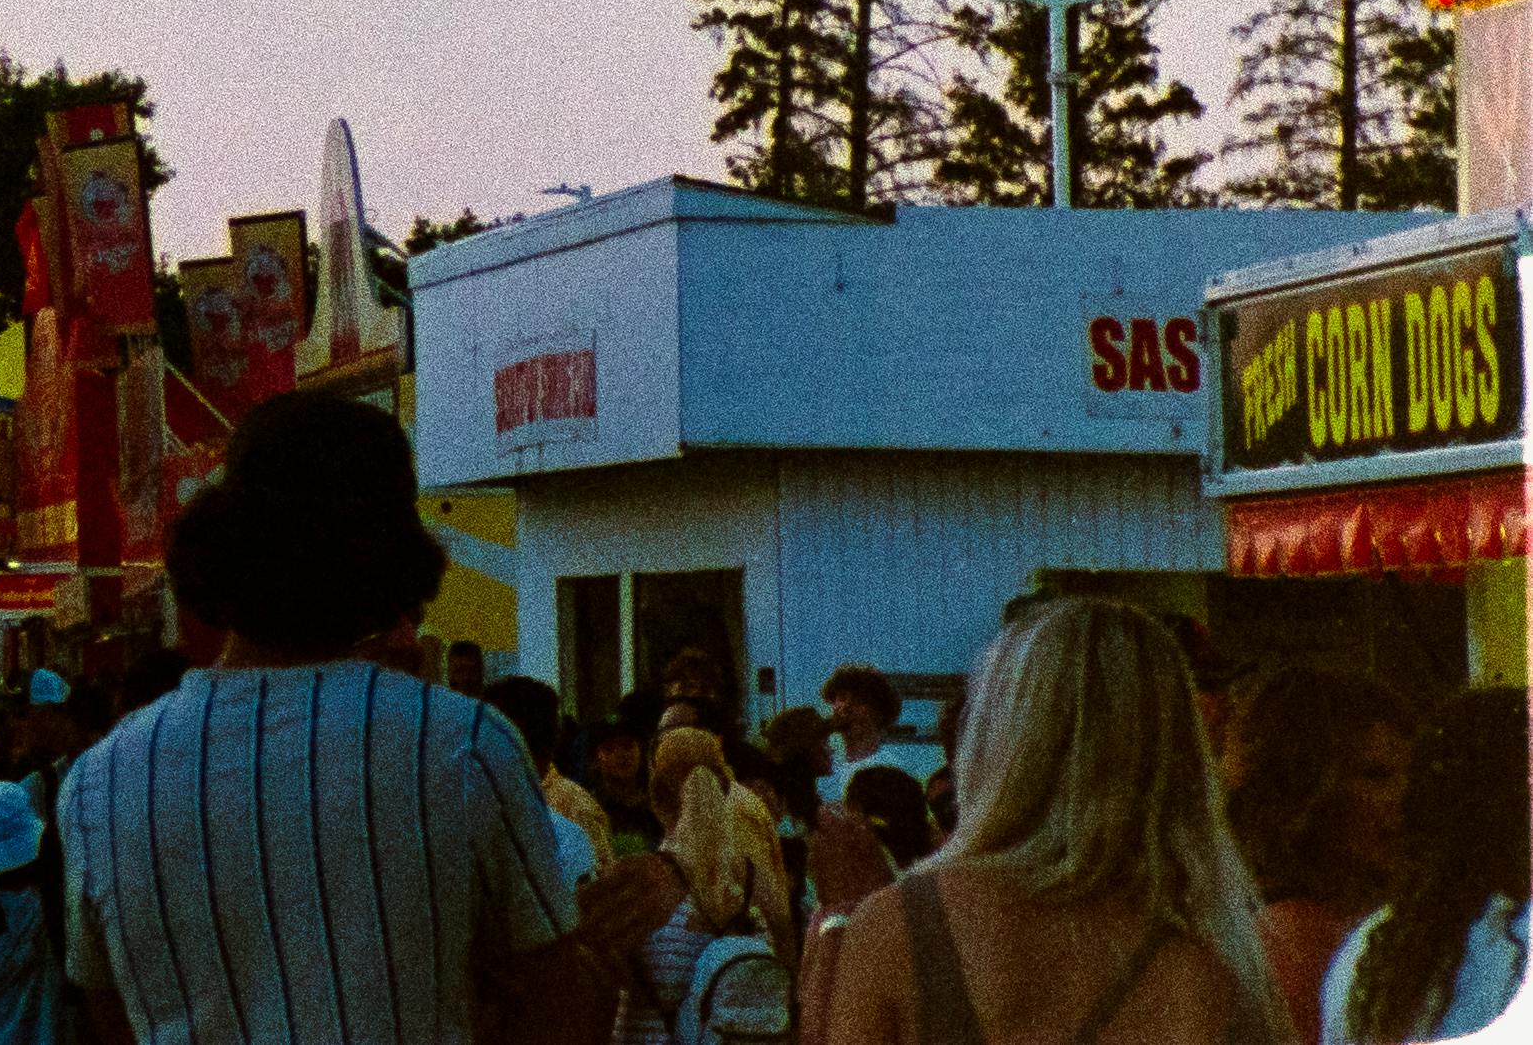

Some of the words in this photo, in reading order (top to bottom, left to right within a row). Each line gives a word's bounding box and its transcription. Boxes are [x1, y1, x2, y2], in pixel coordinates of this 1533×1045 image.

[1089, 316, 1200, 393] SAS
[1241, 317, 1299, 452] FRESH
[1305, 298, 1396, 448] CORN
[1404, 273, 1502, 433] DOGS
